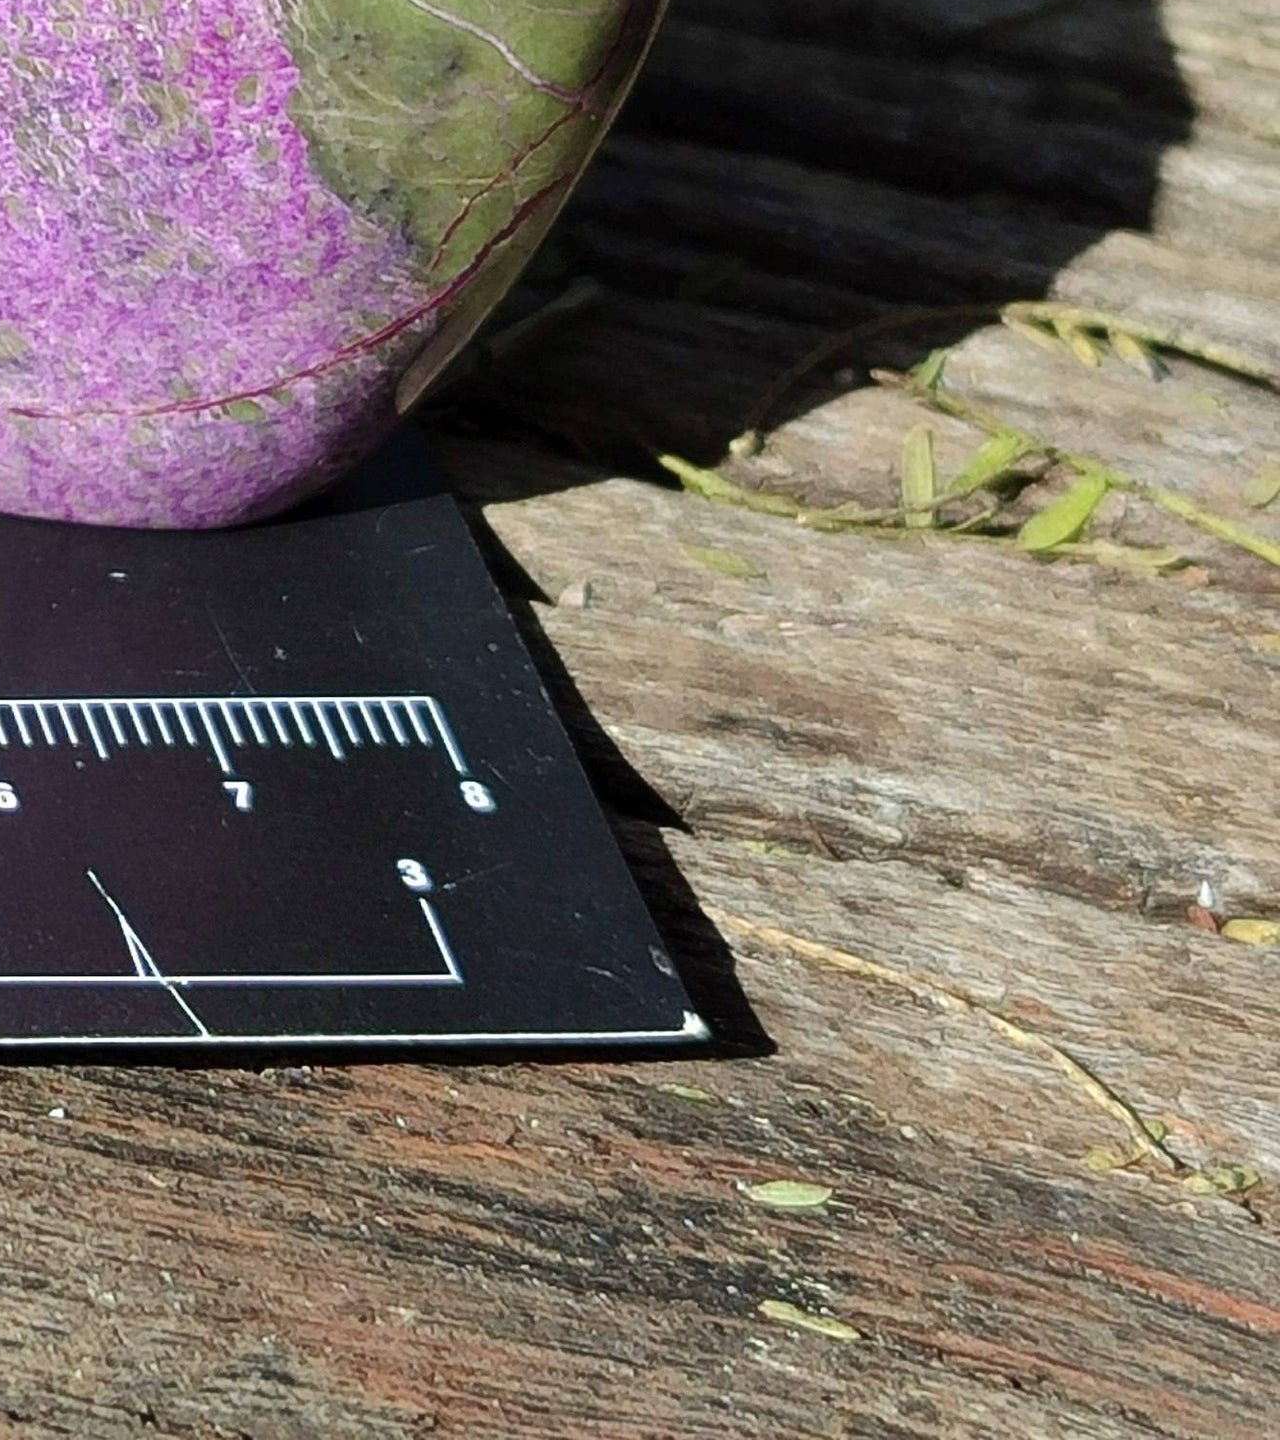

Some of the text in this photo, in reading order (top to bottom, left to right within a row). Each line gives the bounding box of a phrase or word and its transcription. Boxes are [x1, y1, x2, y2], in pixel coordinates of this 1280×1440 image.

[221, 781, 252, 810] 7
[460, 780, 494, 811] 8
[396, 858, 432, 891] 3
